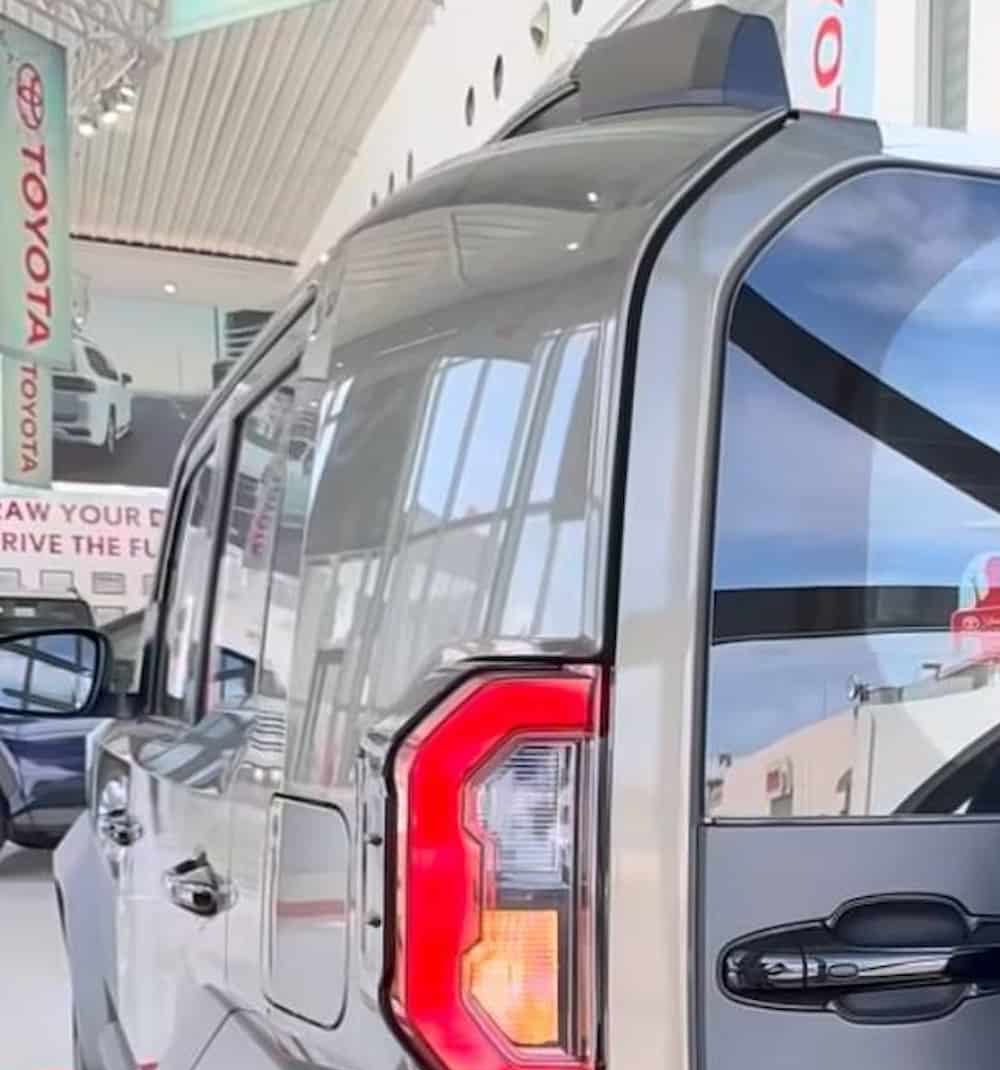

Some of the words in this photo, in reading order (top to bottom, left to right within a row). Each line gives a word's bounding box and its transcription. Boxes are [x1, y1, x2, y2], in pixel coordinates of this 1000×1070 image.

[21, 144, 50, 344] TOYOTA
[21, 360, 38, 472] TOYOTA
[0, 501, 50, 523] AW
[61, 504, 140, 527] YOUR
[72, 535, 121, 557] THE
